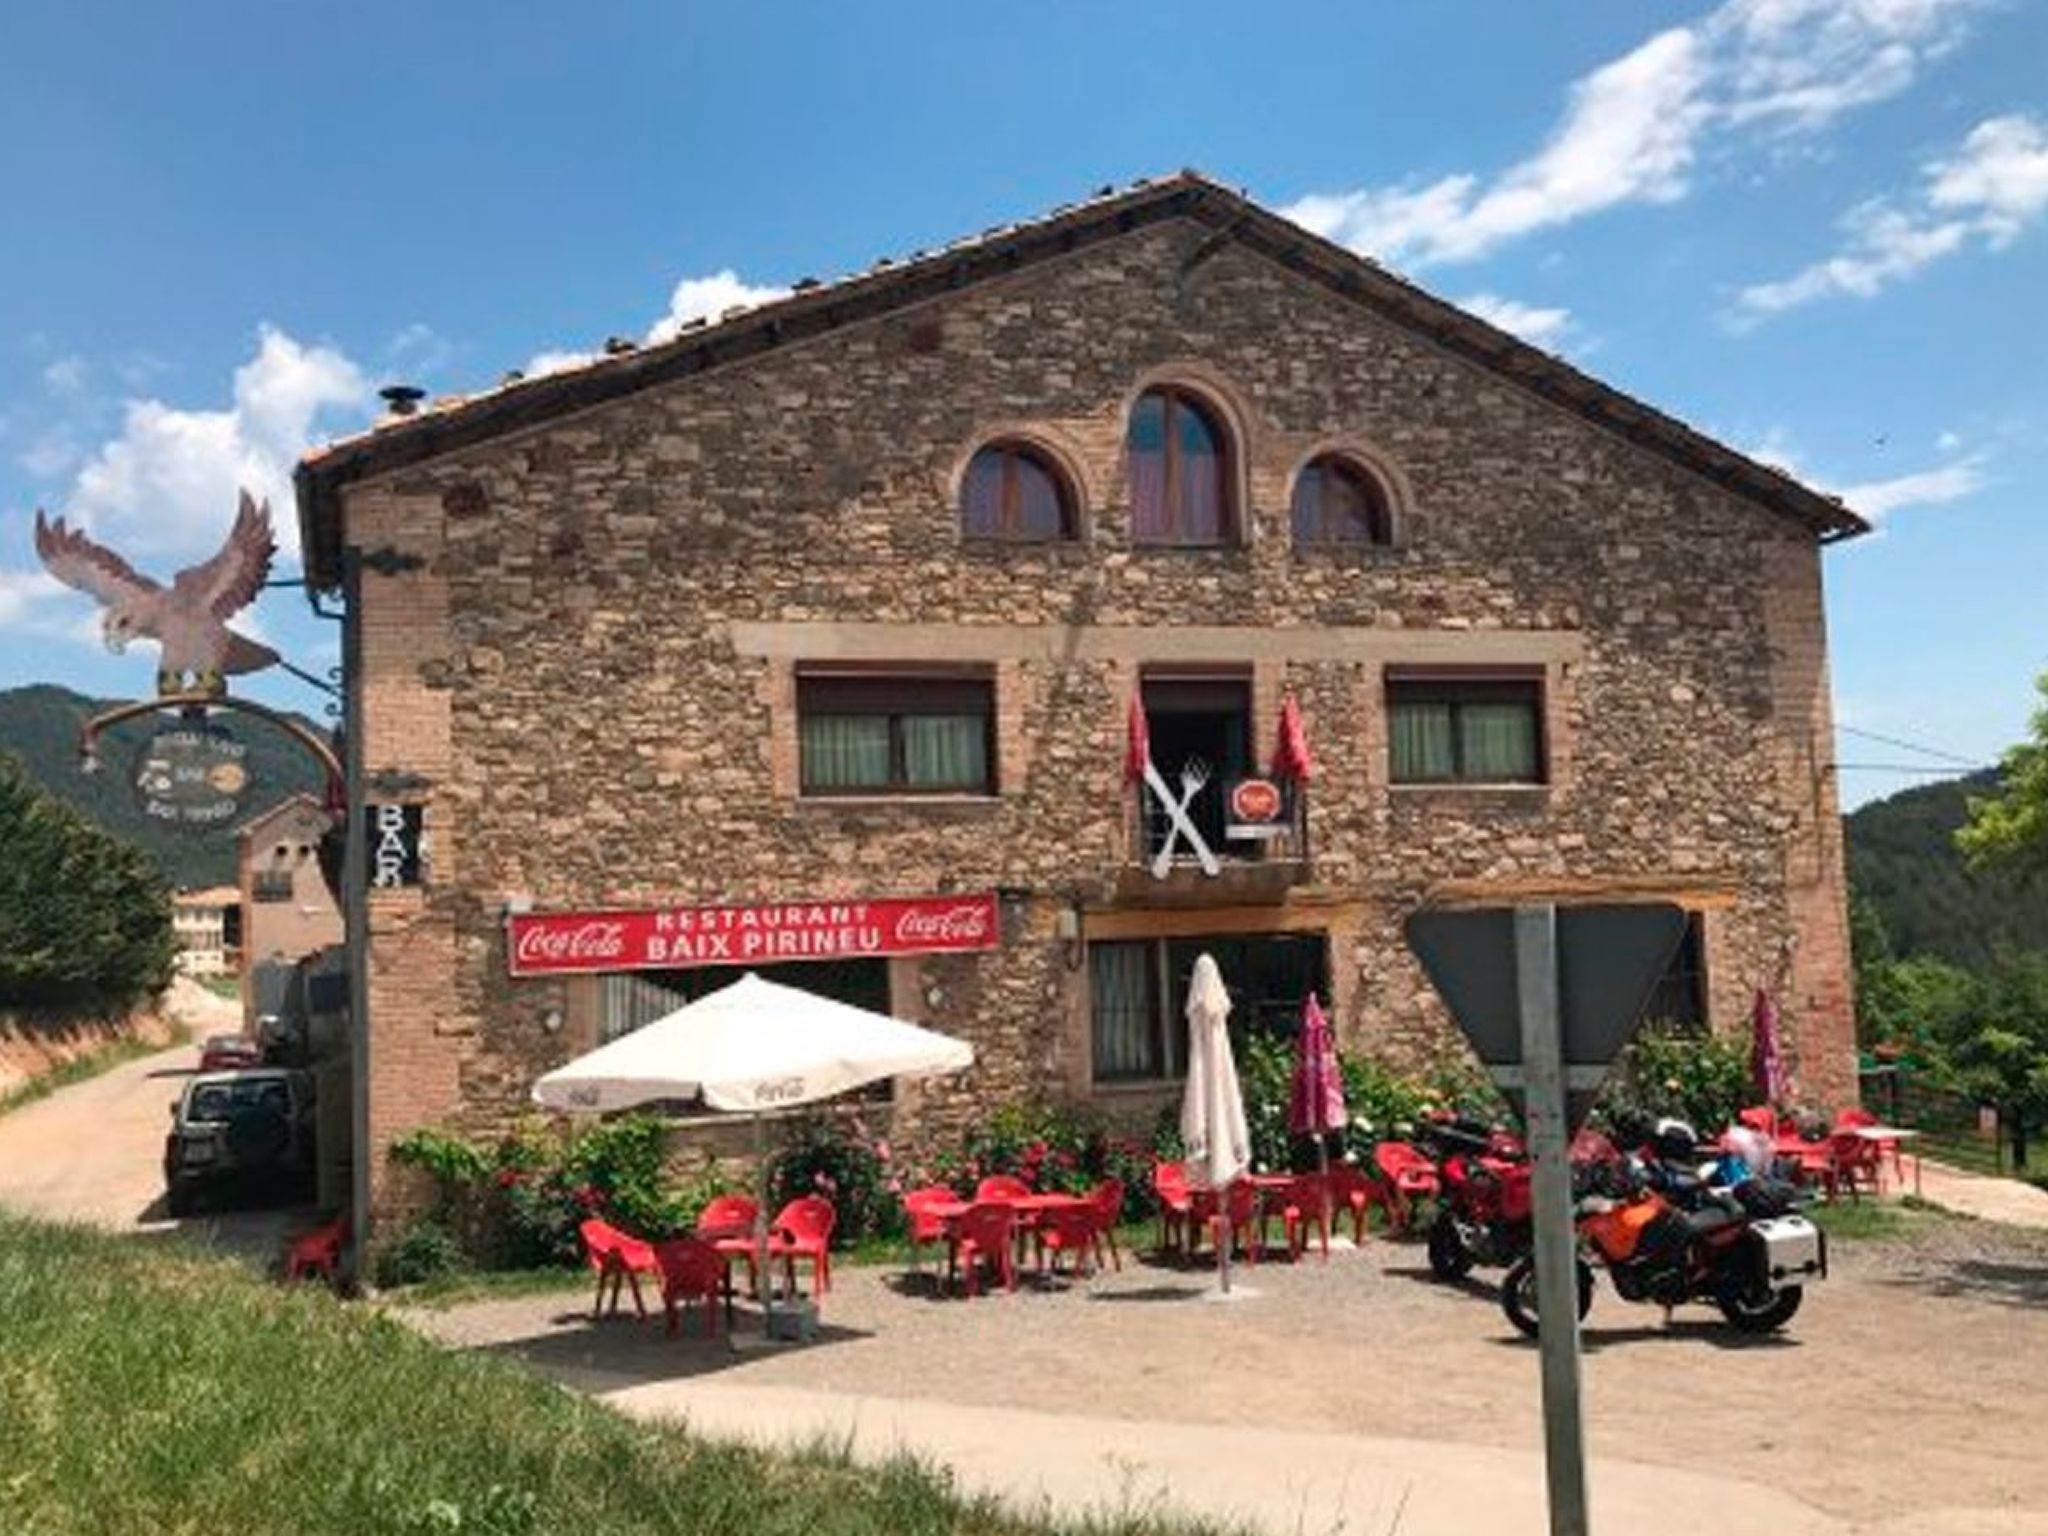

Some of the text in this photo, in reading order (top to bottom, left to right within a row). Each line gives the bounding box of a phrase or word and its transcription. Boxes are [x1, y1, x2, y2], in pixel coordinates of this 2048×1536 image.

[372, 804, 407, 887] BAR
[657, 906, 868, 931] RESTAURANT
[647, 926, 881, 961] BAIX PIRINEU
